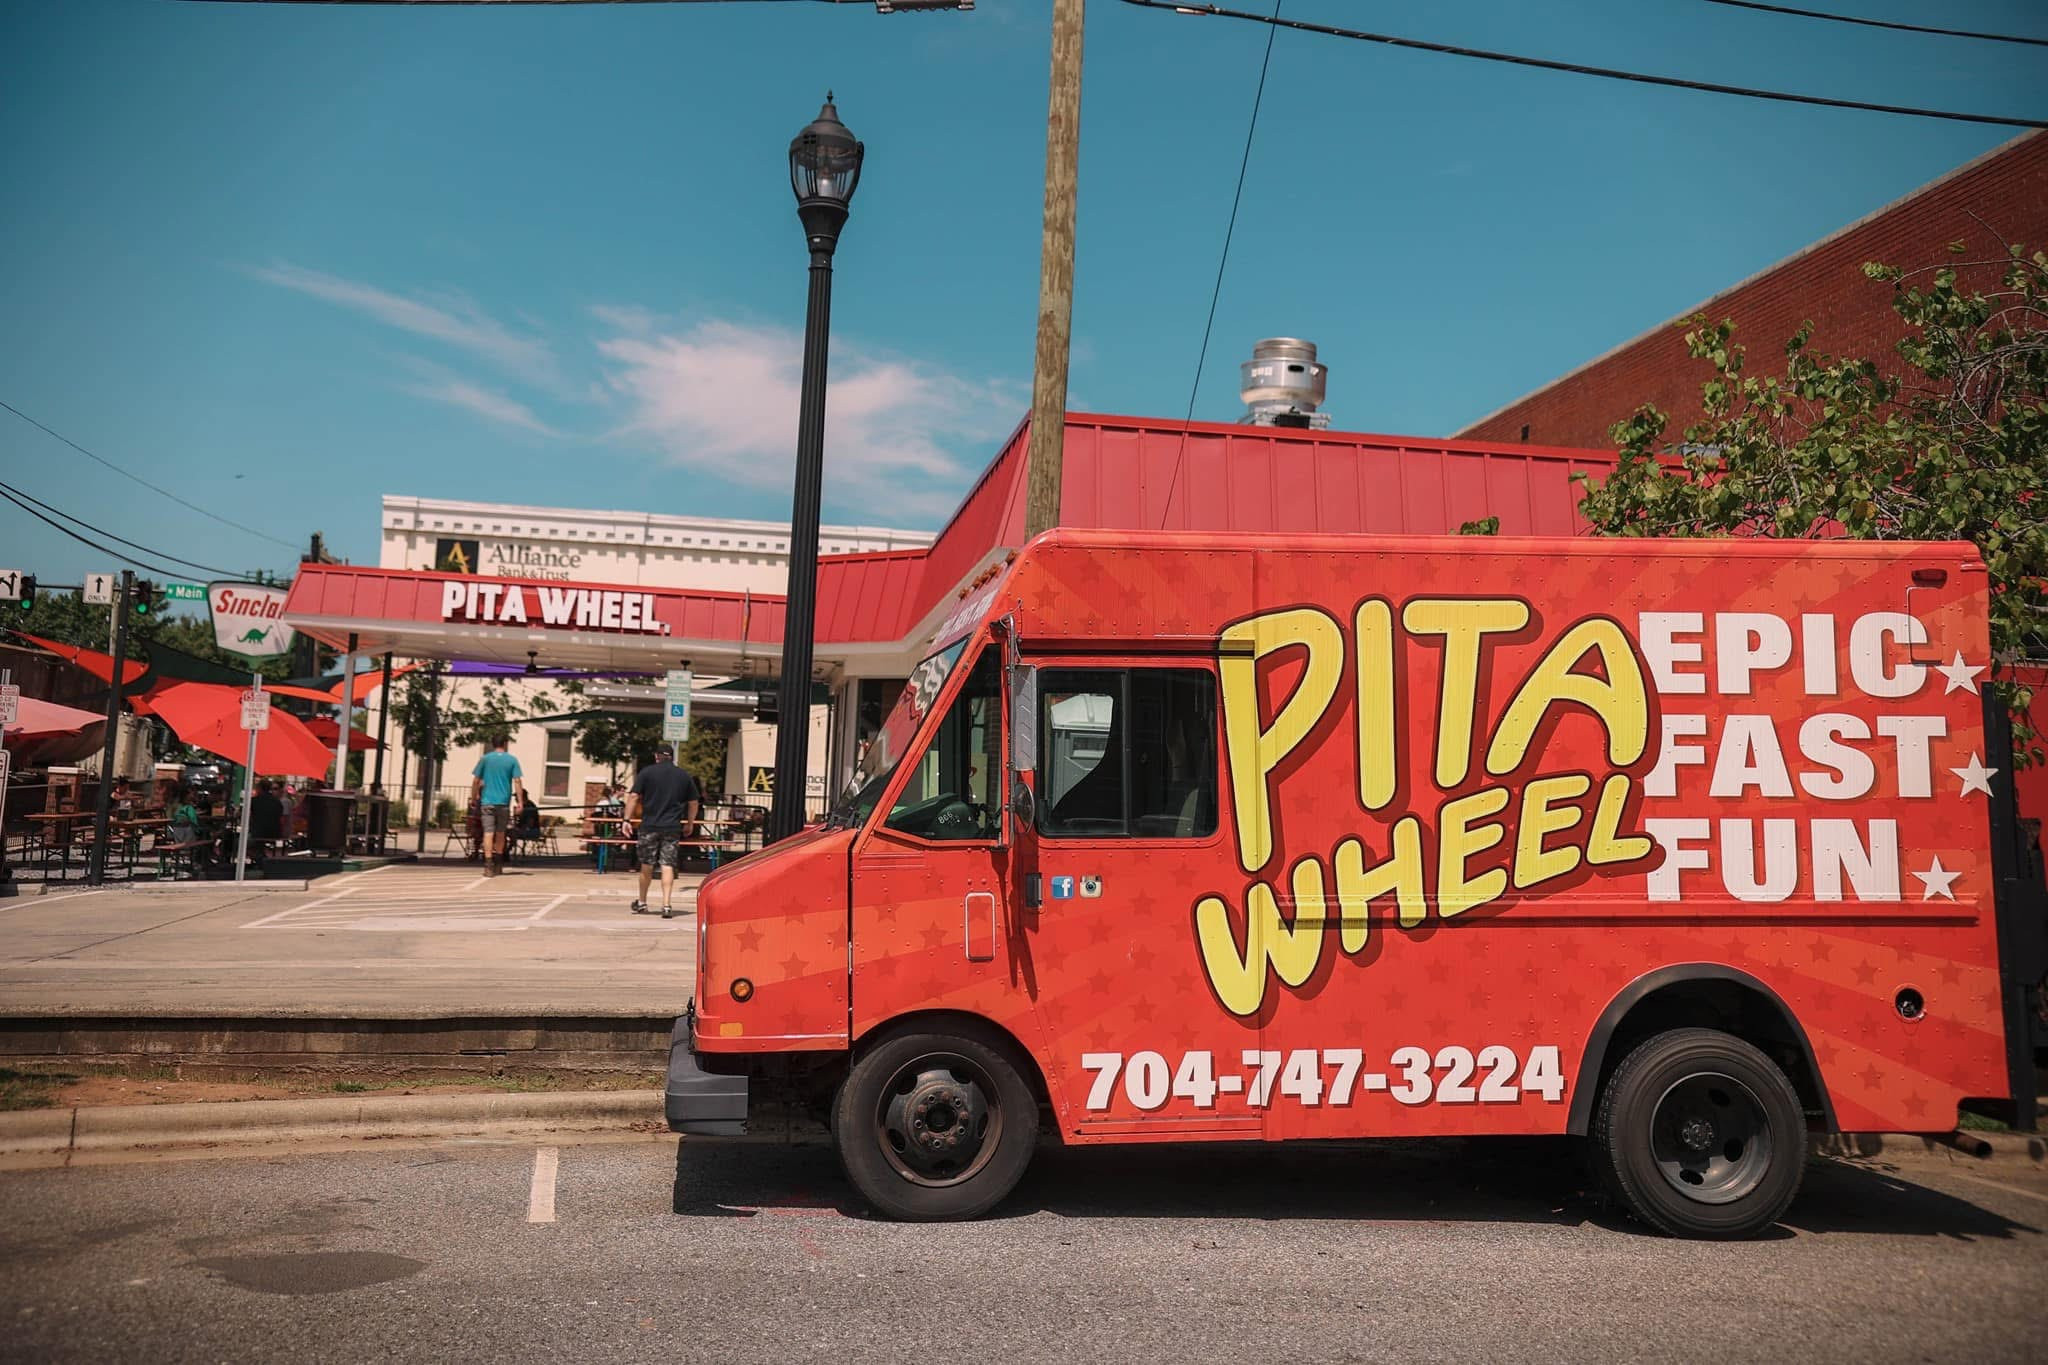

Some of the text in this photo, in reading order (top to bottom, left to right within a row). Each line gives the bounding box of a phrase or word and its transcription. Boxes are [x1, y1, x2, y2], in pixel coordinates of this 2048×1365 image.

[175, 585, 203, 599] Main
[488, 544, 581, 568] Alliance
[87, 594, 108, 602] ONLY
[441, 580, 528, 624] PITA
[1638, 612, 1929, 698] EPIC
[1218, 595, 1649, 873] PITA
[1643, 712, 1947, 800] FAST
[1195, 772, 1655, 1017] WHEEL
[1643, 818, 1902, 902] FUN
[1080, 1044, 1565, 1110] 704-747-3224
